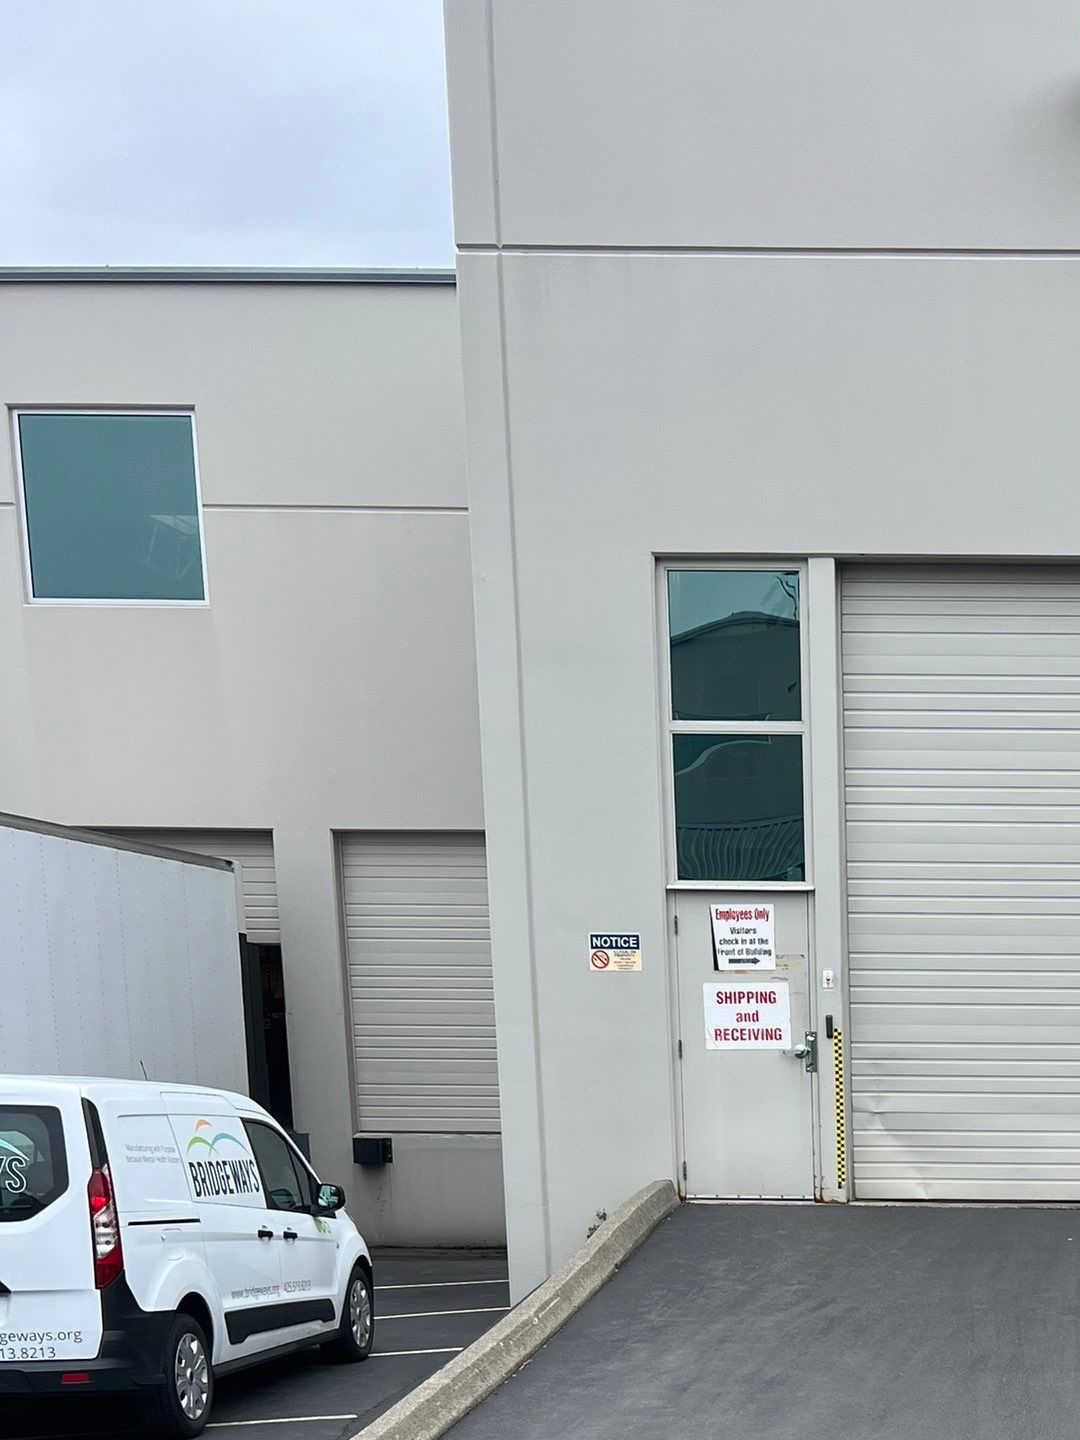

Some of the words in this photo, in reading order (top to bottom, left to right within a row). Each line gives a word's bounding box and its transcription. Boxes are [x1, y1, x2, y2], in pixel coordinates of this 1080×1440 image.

[715, 908, 752, 921] Employees
[754, 908, 769, 921] Only
[592, 936, 638, 948] NOTICE
[746, 948, 772, 956] Building
[716, 990, 776, 1004] SHIPPING
[736, 1010, 759, 1022] and
[714, 1028, 782, 1041] RECEIVING
[188, 1159, 260, 1197] BRIDGEWAYS
[0, 1331, 82, 1346] geways.org
[0, 1346, 56, 1359] 13.8213
